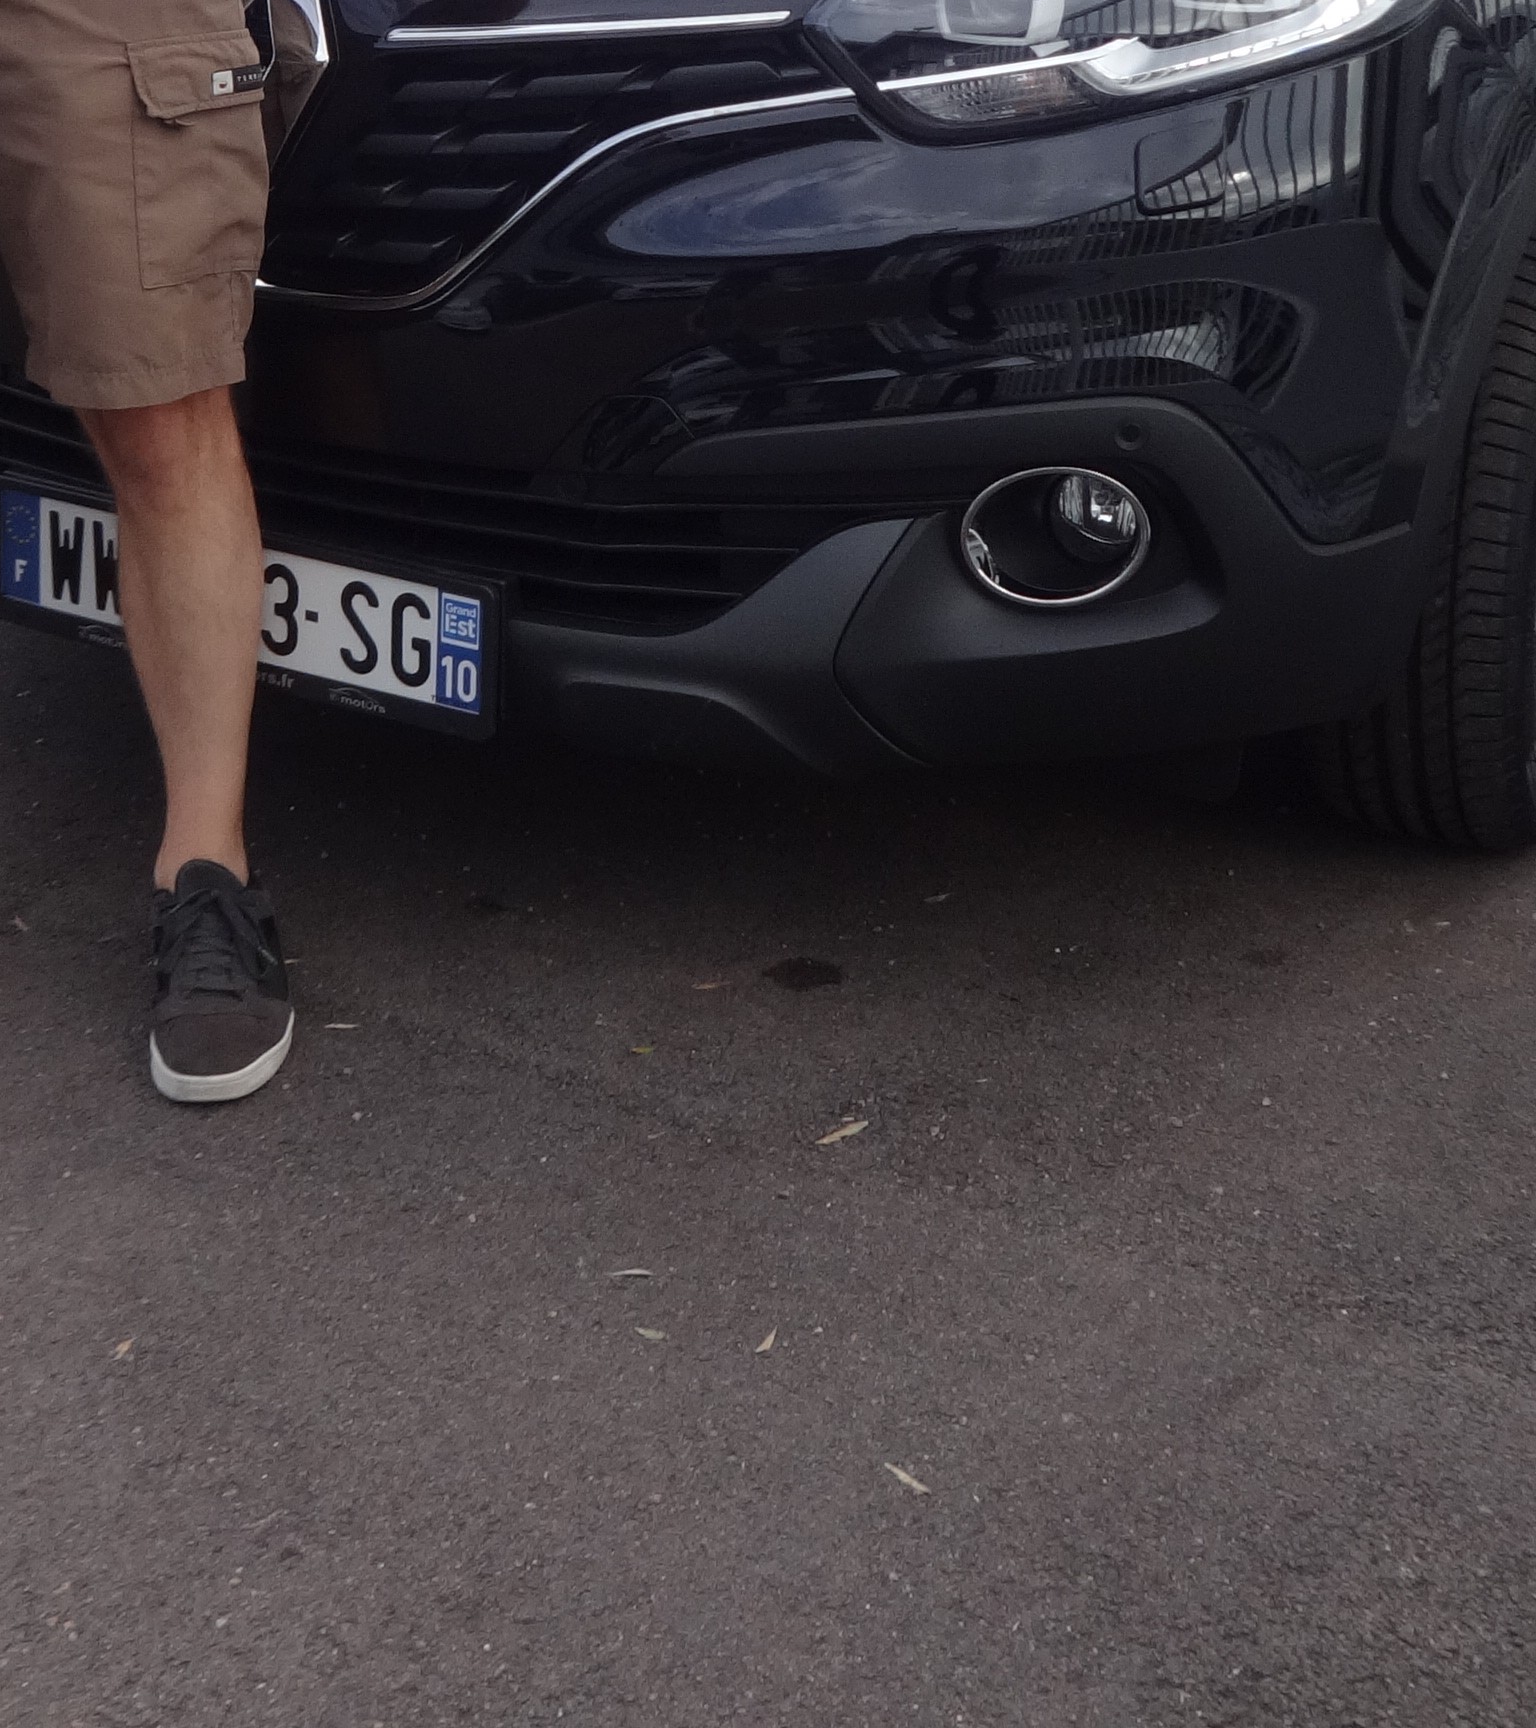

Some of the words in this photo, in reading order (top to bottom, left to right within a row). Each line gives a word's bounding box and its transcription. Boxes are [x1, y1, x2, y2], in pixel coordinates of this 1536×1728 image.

[14, 558, 28, 583] F
[445, 602, 477, 619] Grand
[444, 613, 476, 638] Est
[441, 655, 477, 704] 10
